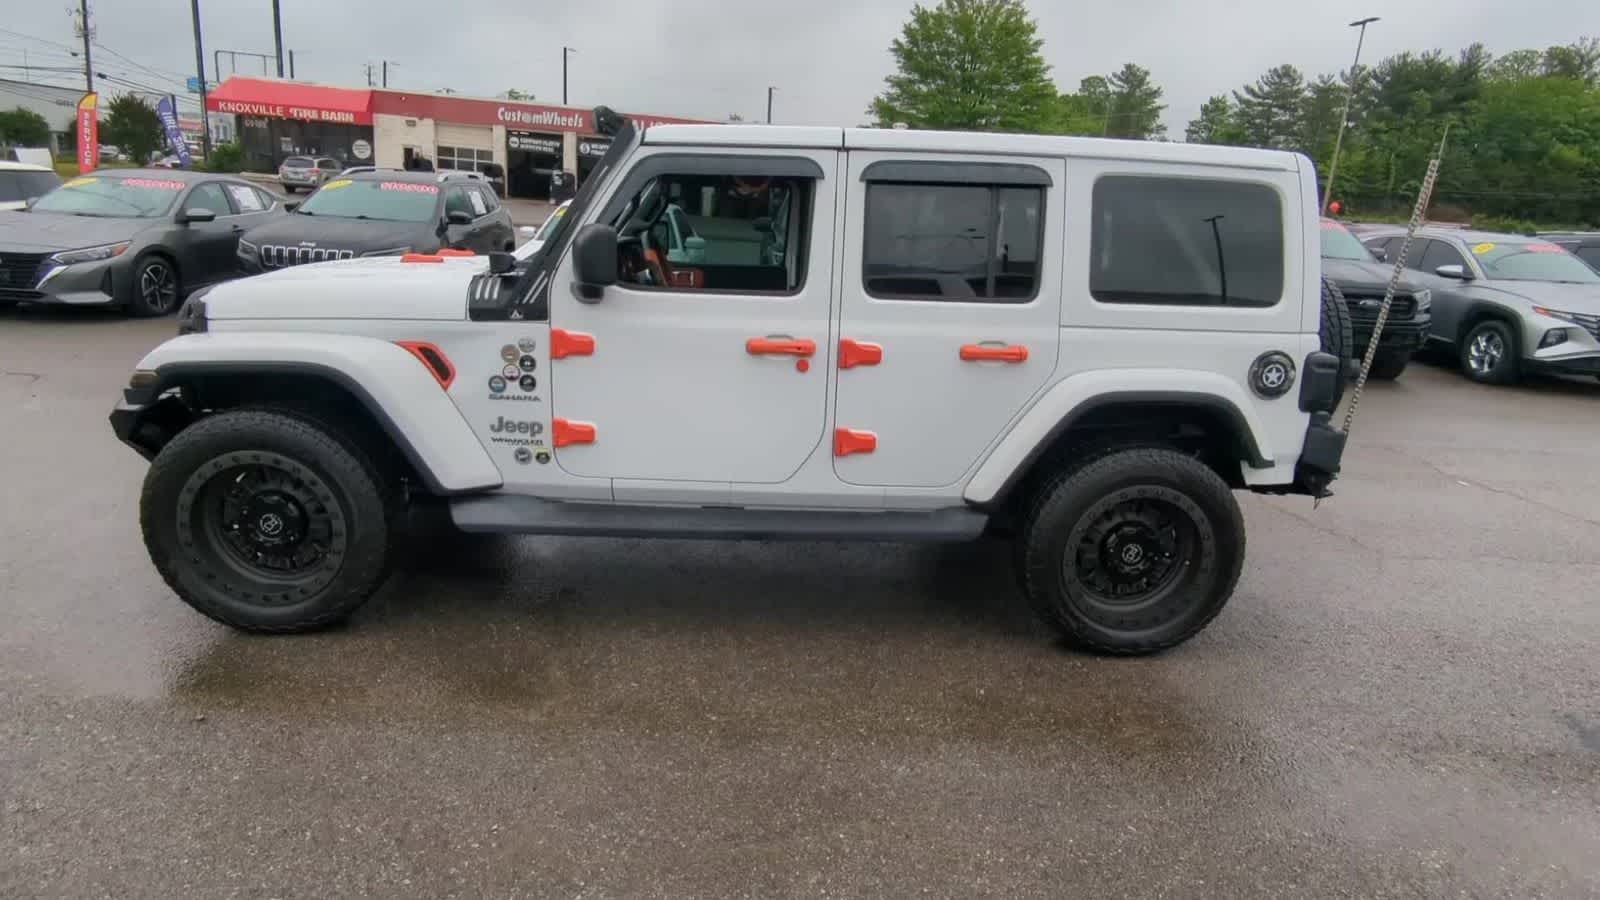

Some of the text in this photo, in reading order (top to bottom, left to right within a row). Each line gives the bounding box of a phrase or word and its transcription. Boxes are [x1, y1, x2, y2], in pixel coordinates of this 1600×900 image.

[161, 111, 178, 132] TIRE
[218, 101, 355, 123] KNOXVILLE TIRE BARN
[489, 415, 544, 438] Jeep
